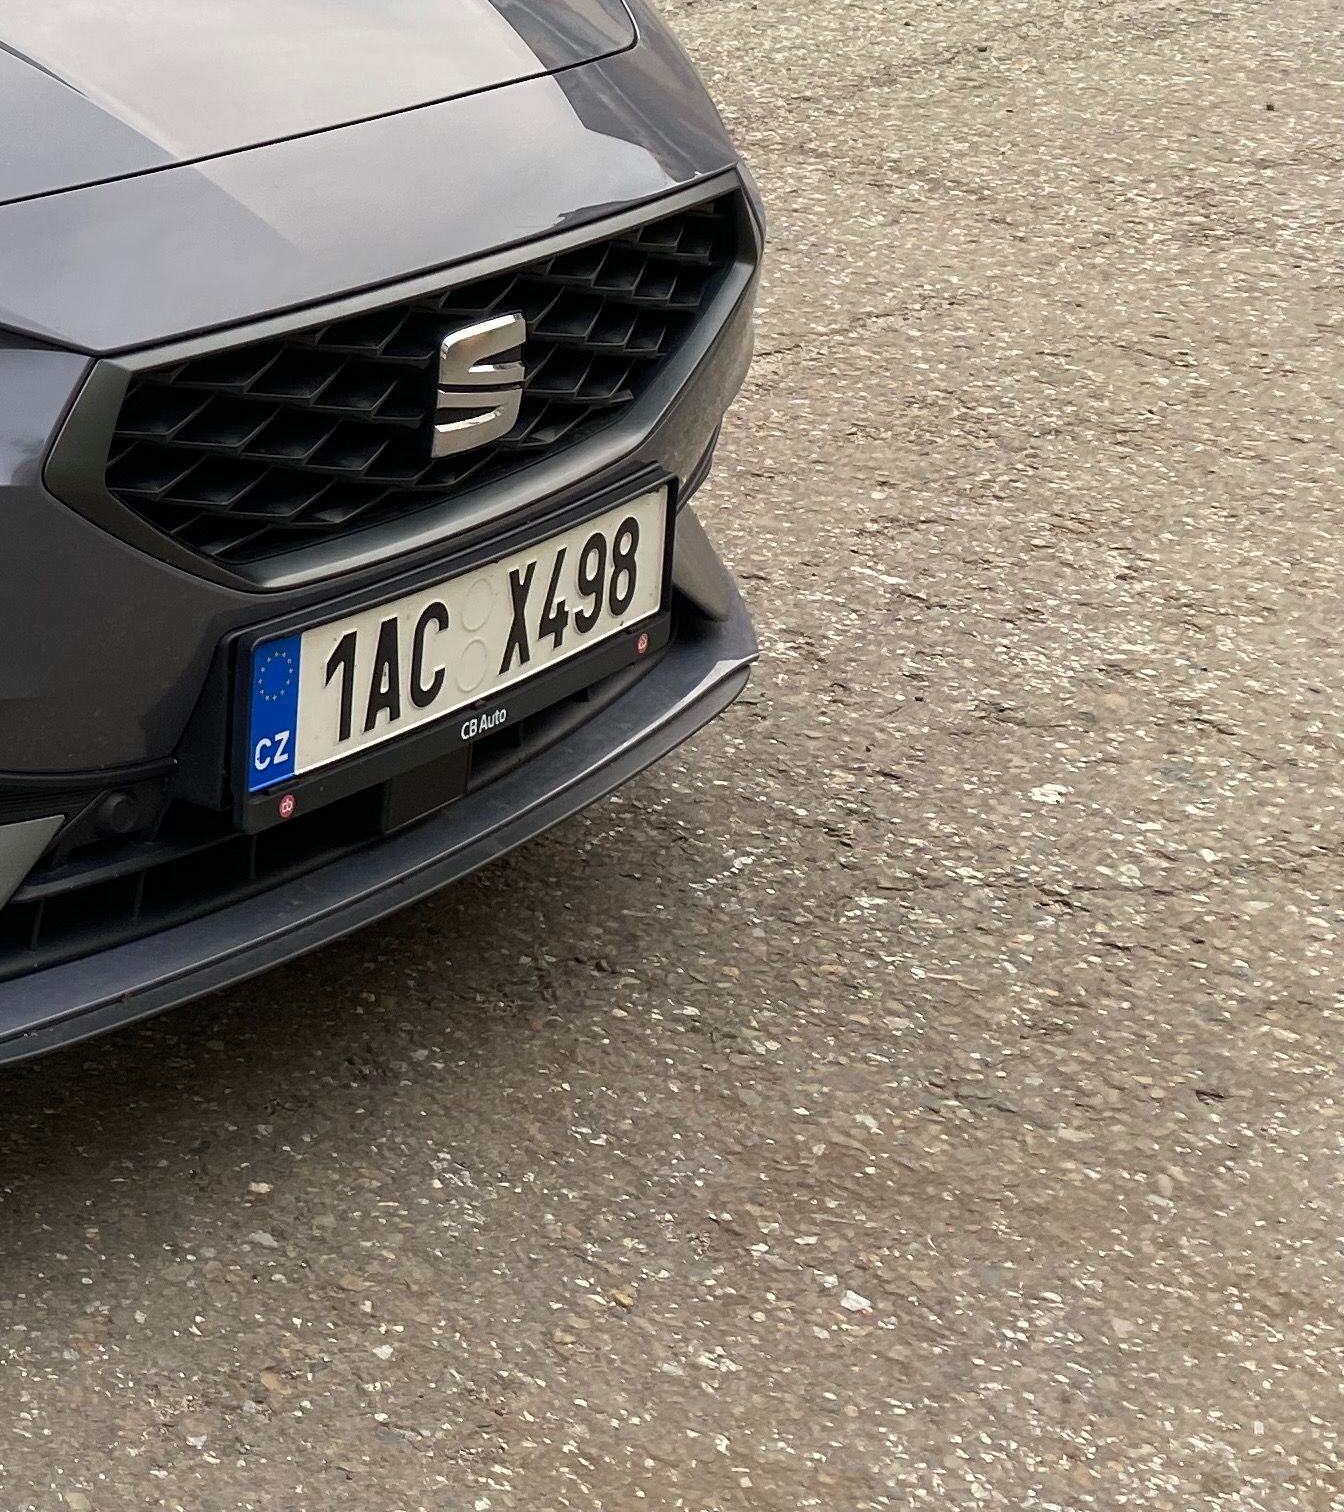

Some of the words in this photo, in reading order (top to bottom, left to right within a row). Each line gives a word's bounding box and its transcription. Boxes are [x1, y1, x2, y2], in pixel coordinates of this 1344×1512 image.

[323, 601, 450, 743] 1AC
[498, 516, 640, 676] X498
[461, 718, 477, 740] CB
[478, 709, 507, 733] Auto
[254, 731, 290, 771] CZ
